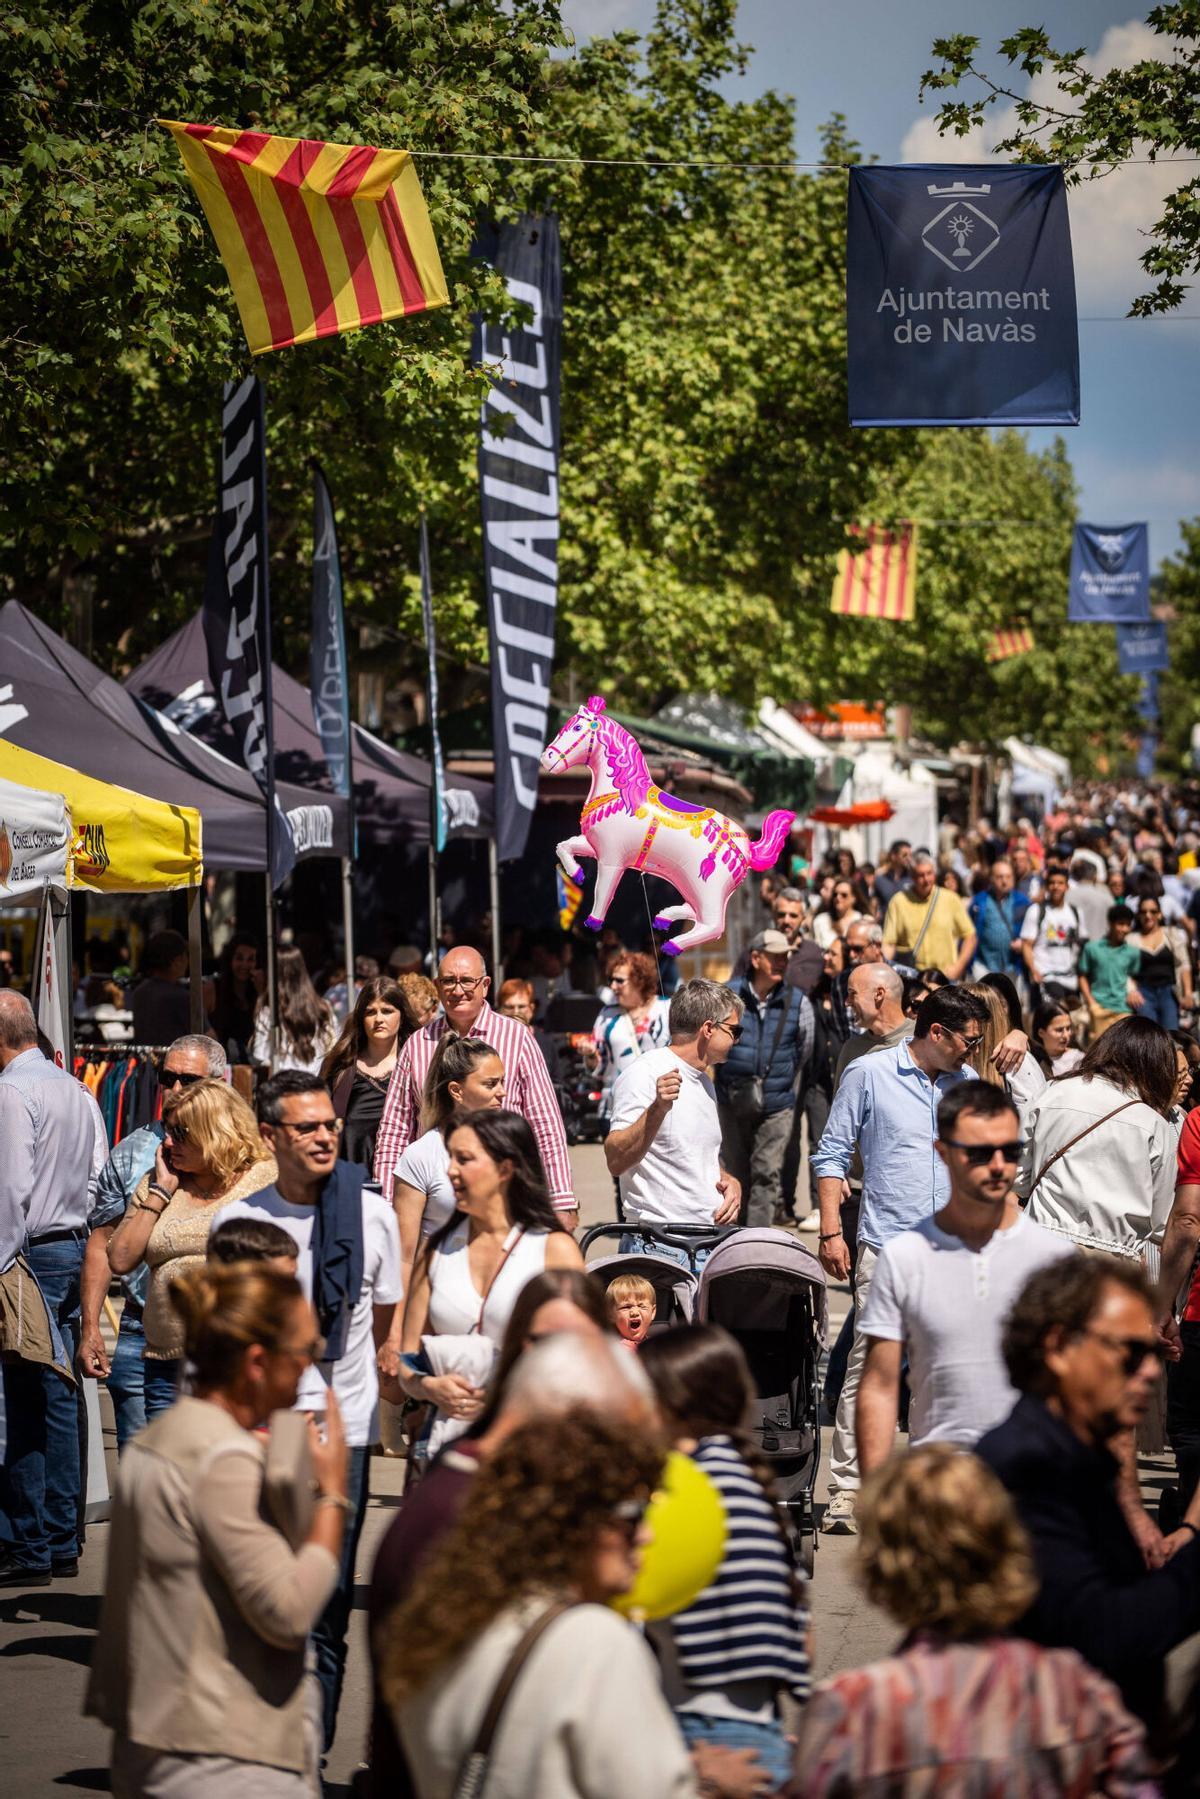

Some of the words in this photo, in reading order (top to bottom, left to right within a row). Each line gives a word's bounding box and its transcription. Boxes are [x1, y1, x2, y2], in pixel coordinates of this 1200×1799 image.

[876, 286, 1050, 317] Ajuntament
[894, 319, 932, 343] de
[943, 317, 1036, 342] Navàs
